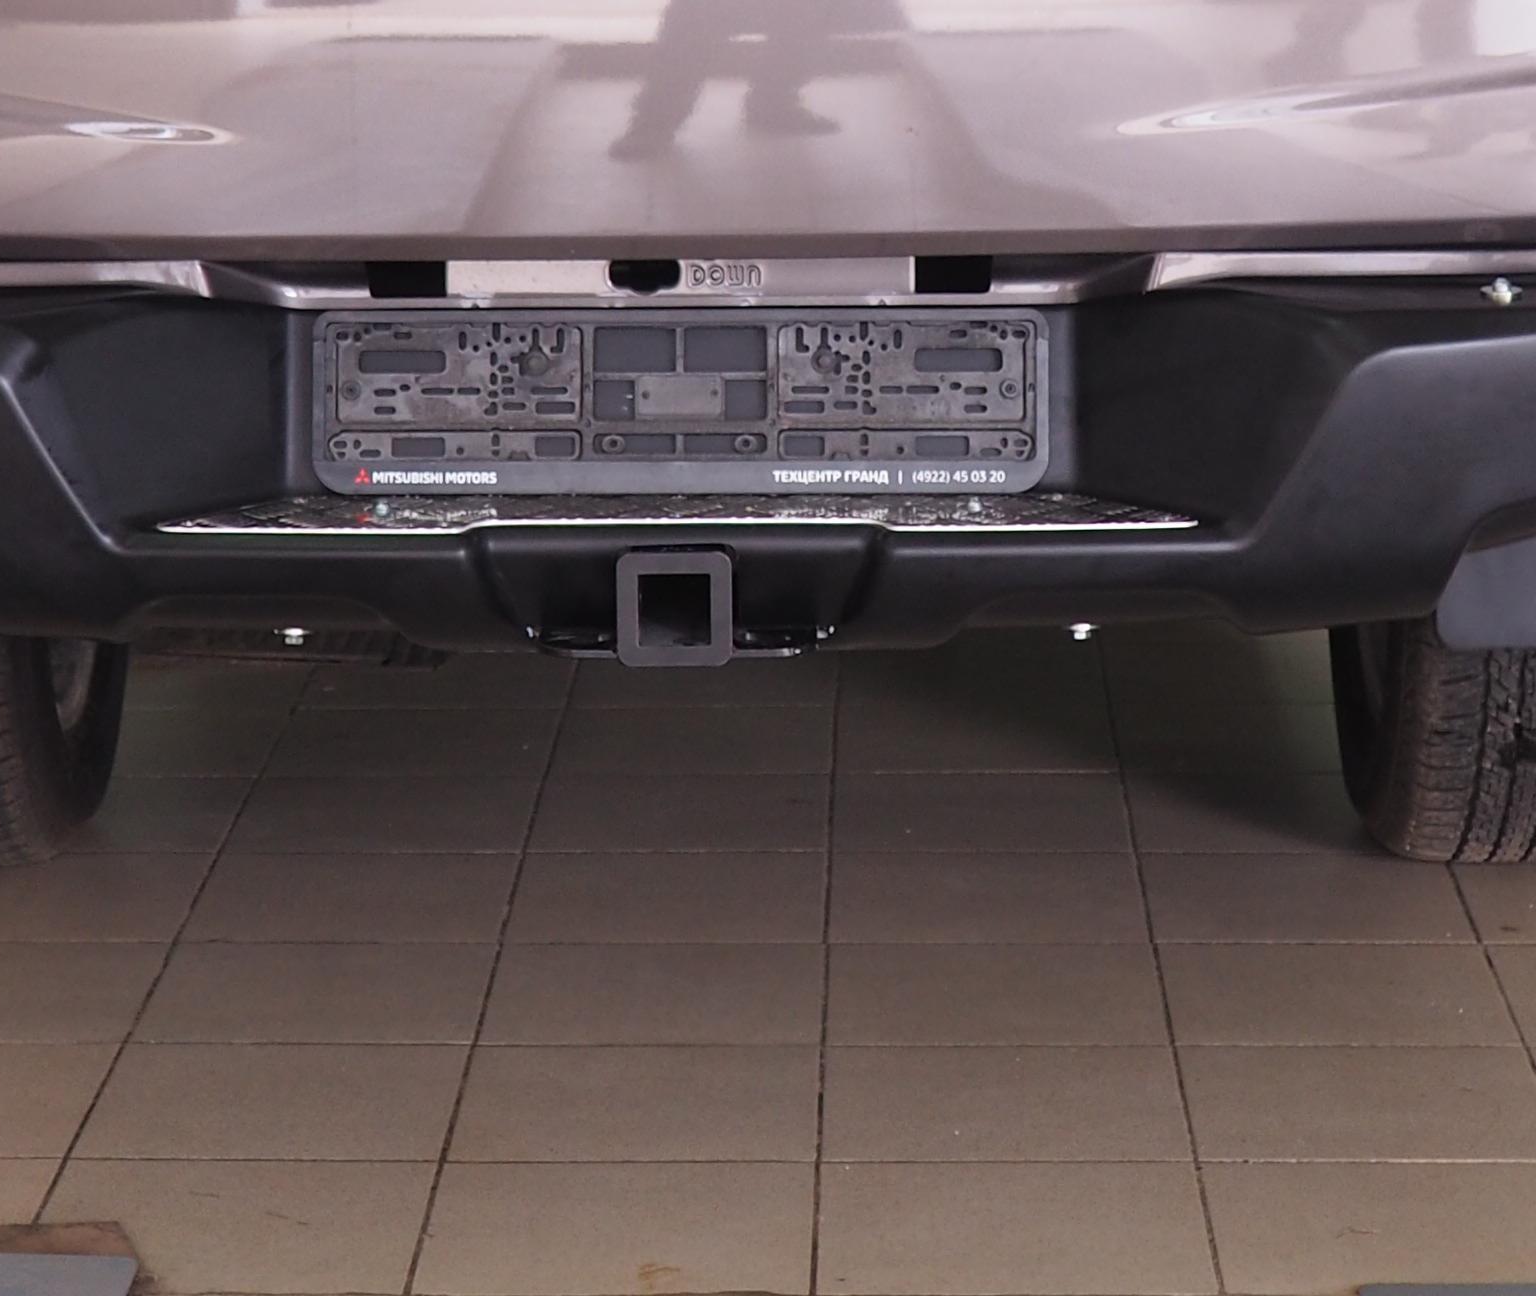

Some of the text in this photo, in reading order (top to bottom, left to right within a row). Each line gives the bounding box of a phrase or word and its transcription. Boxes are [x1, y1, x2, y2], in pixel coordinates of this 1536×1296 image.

[372, 471, 498, 484] MITSUBISHI MOTORS
[772, 470, 841, 485] ТЕХЦЕНТР
[844, 470, 889, 485] ГРАНД
[912, 470, 951, 484] (4922)
[952, 470, 968, 483] 45
[970, 470, 987, 483] 03
[989, 470, 1006, 483] 20
